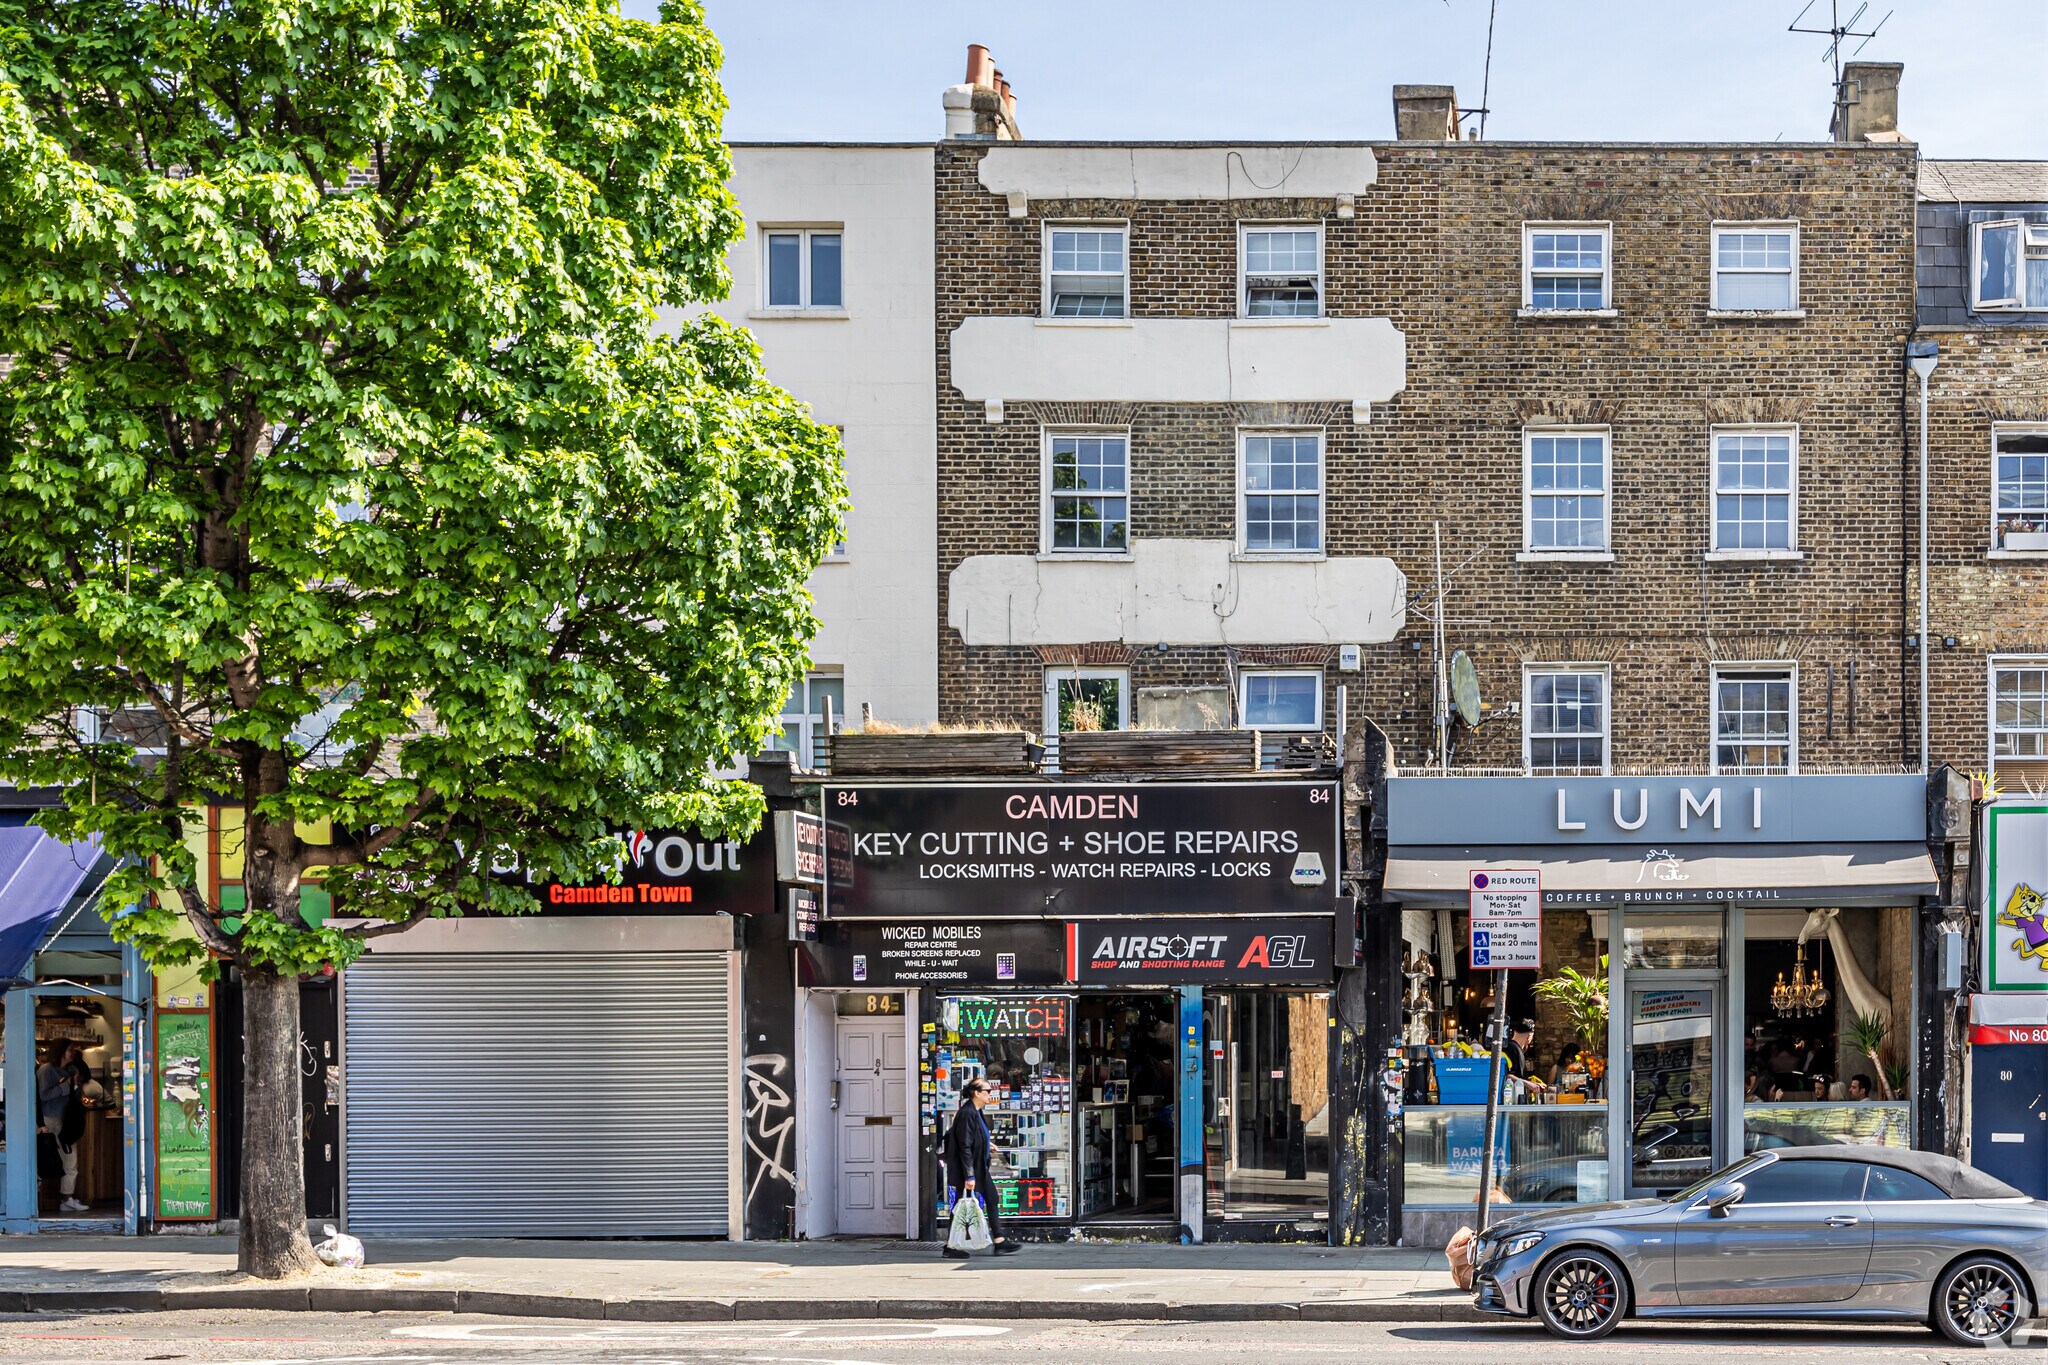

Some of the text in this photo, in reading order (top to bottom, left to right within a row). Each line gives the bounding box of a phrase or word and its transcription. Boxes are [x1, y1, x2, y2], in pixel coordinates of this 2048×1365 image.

[837, 792, 858, 806] 84
[1309, 789, 1329, 804] 84
[1005, 794, 1138, 819] CAMDEN
[1557, 788, 1762, 830] LUMI
[854, 832, 912, 856] KEY
[920, 832, 1048, 856] CUTTING
[1059, 836, 1074, 851] +
[1084, 831, 1165, 854] SHOE
[1175, 830, 1299, 854] REPAIRS
[920, 864, 1034, 878] LOCKSMITHS
[1052, 863, 1114, 878] WATCH
[1120, 862, 1196, 878] REPAIRS
[1212, 862, 1271, 877] LOCKS
[550, 884, 692, 904] Camden Town
[1496, 894, 1527, 902] stopping
[1546, 890, 1780, 902] COFFEE BRUNCH COCKTAIL
[882, 926, 982, 940] WICKED MOBILES
[1092, 935, 1314, 968] AIRSOFT AGL
[1091, 960, 1226, 969] SHOP AND SHOOTING RANGE
[866, 995, 890, 1014] 84
[966, 1008, 1064, 1030] WATCH
[2009, 1029, 2028, 1042] No
[2000, 1070, 2012, 1080] 80
